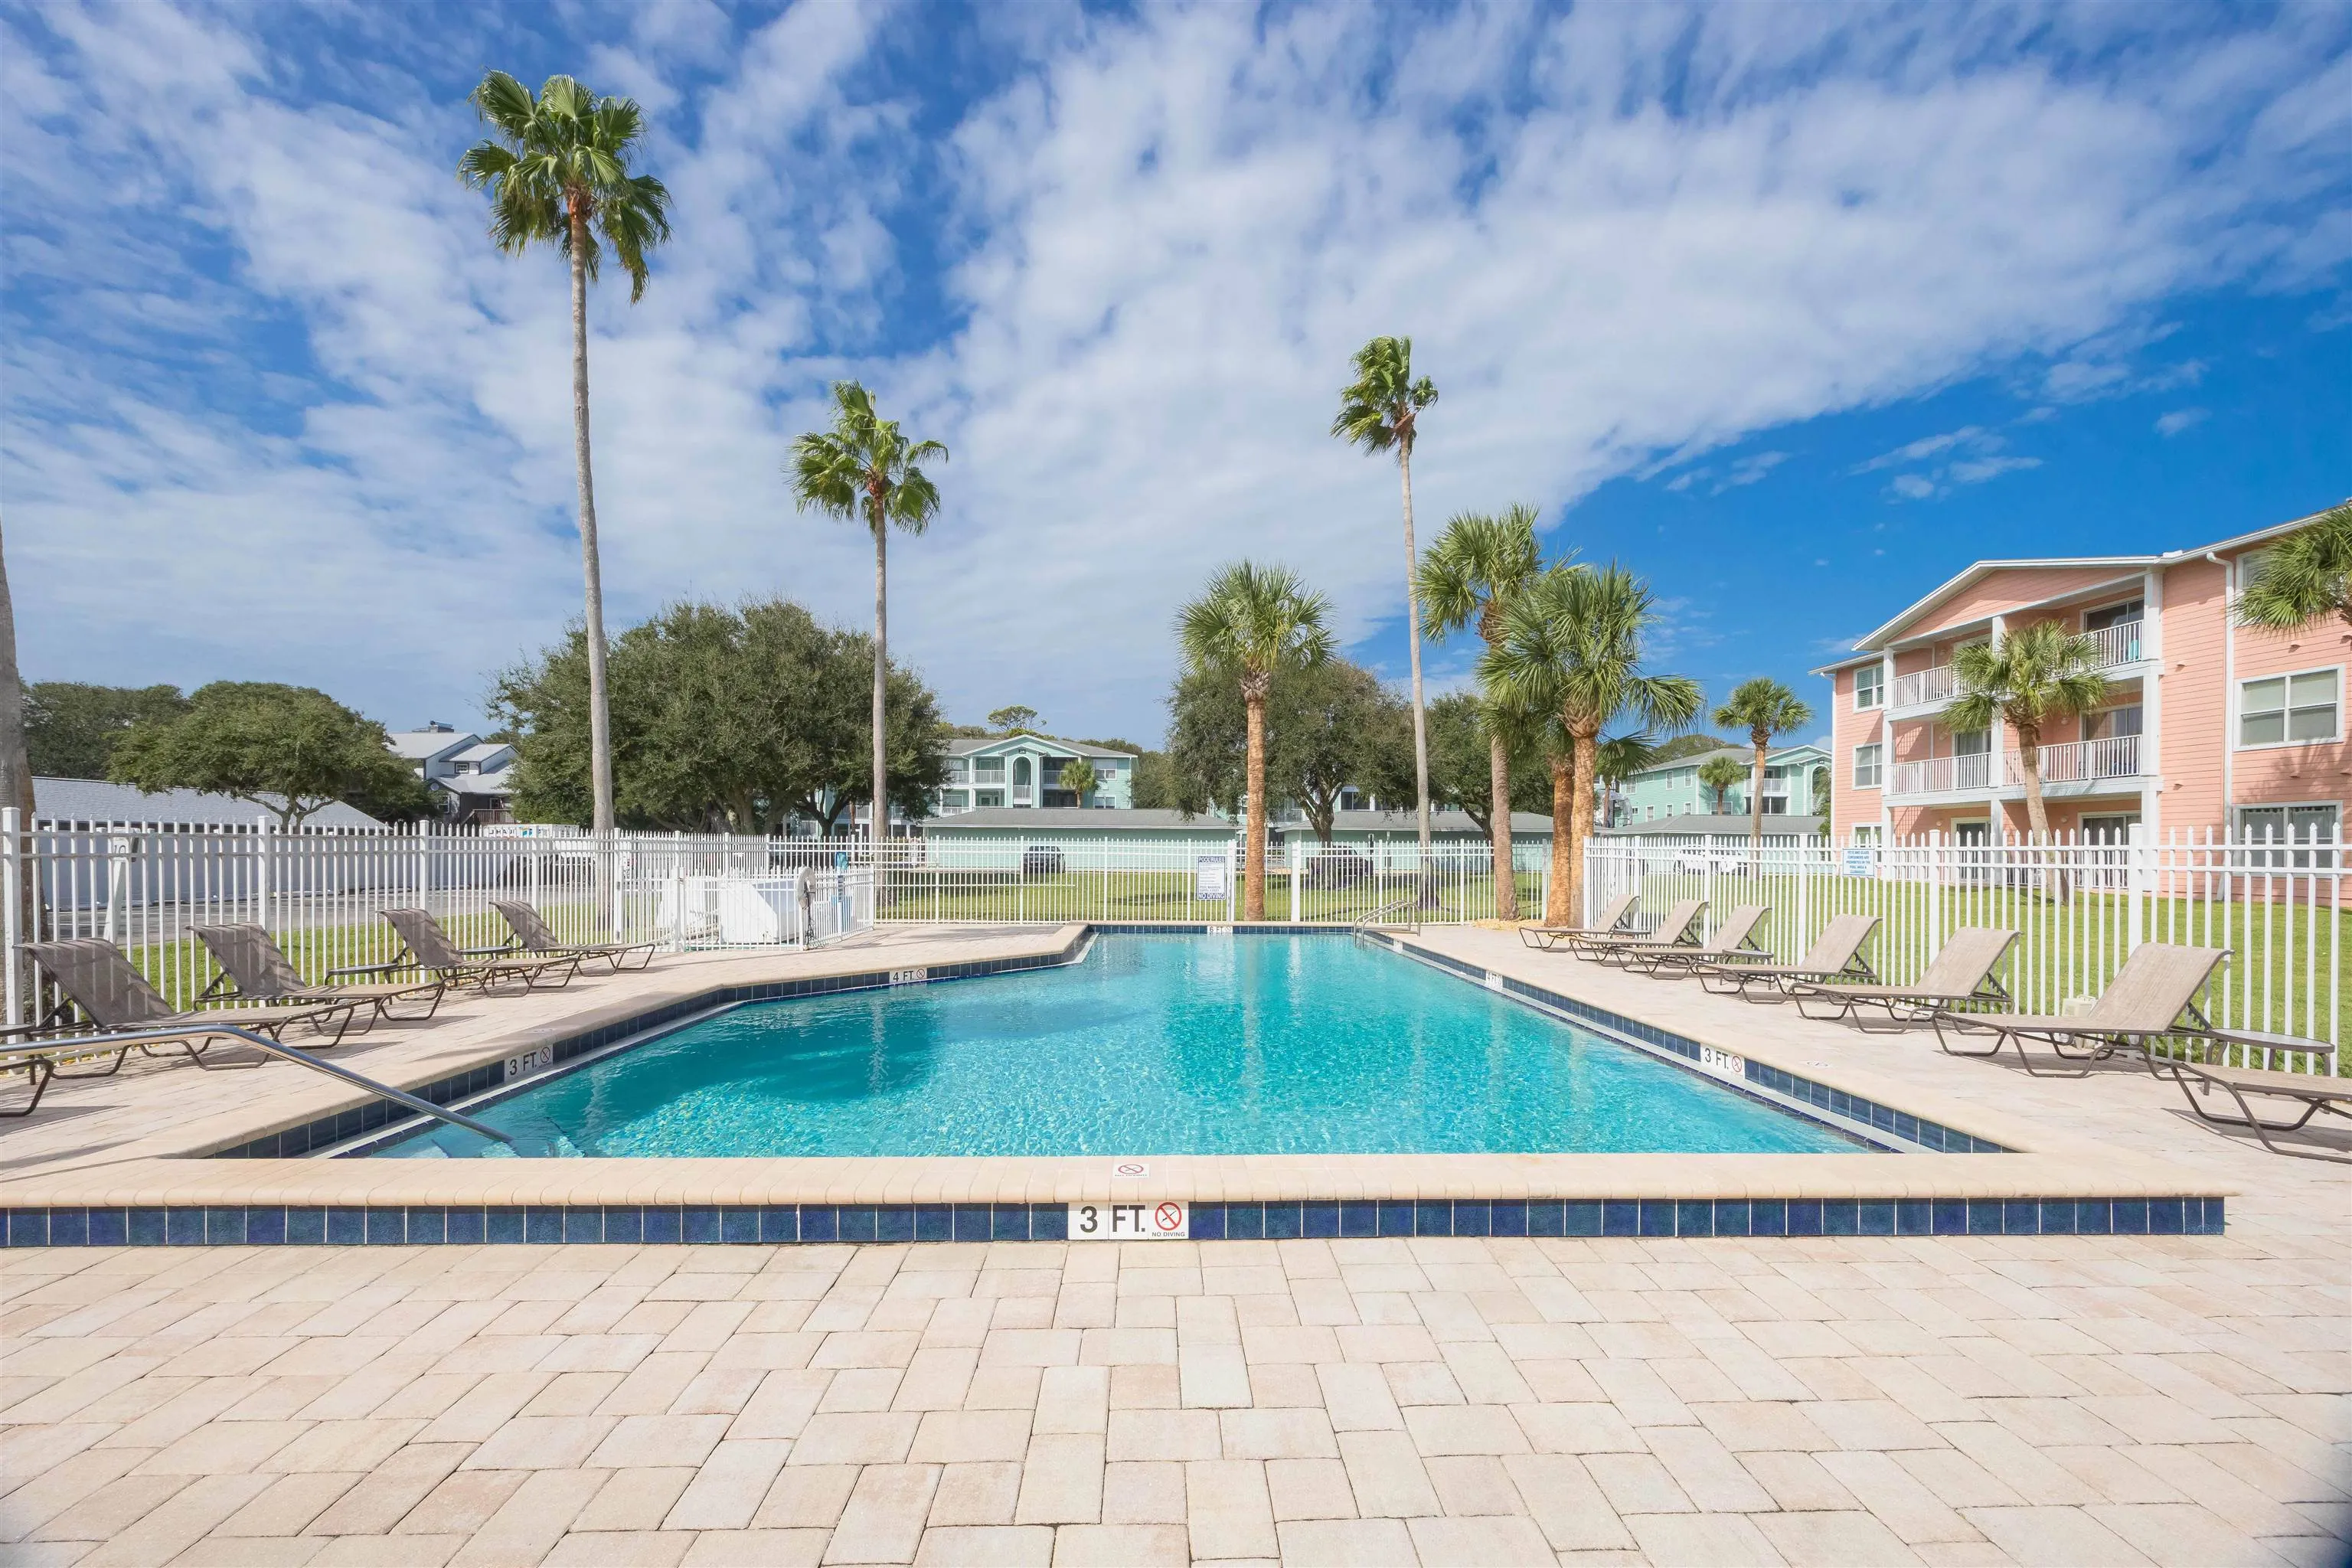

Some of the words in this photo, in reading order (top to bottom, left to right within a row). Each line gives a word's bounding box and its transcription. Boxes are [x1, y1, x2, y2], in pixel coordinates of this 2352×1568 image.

[893, 972, 899, 982] 4
[903, 970, 914, 980] FT.
[509, 1059, 518, 1076] 3
[523, 1051, 537, 1071] FT.
[1705, 1047, 1711, 1063] 3
[1716, 1050, 1729, 1070] FT.
[1080, 1205, 1098, 1233] 3
[1112, 1205, 1146, 1233] FT.
